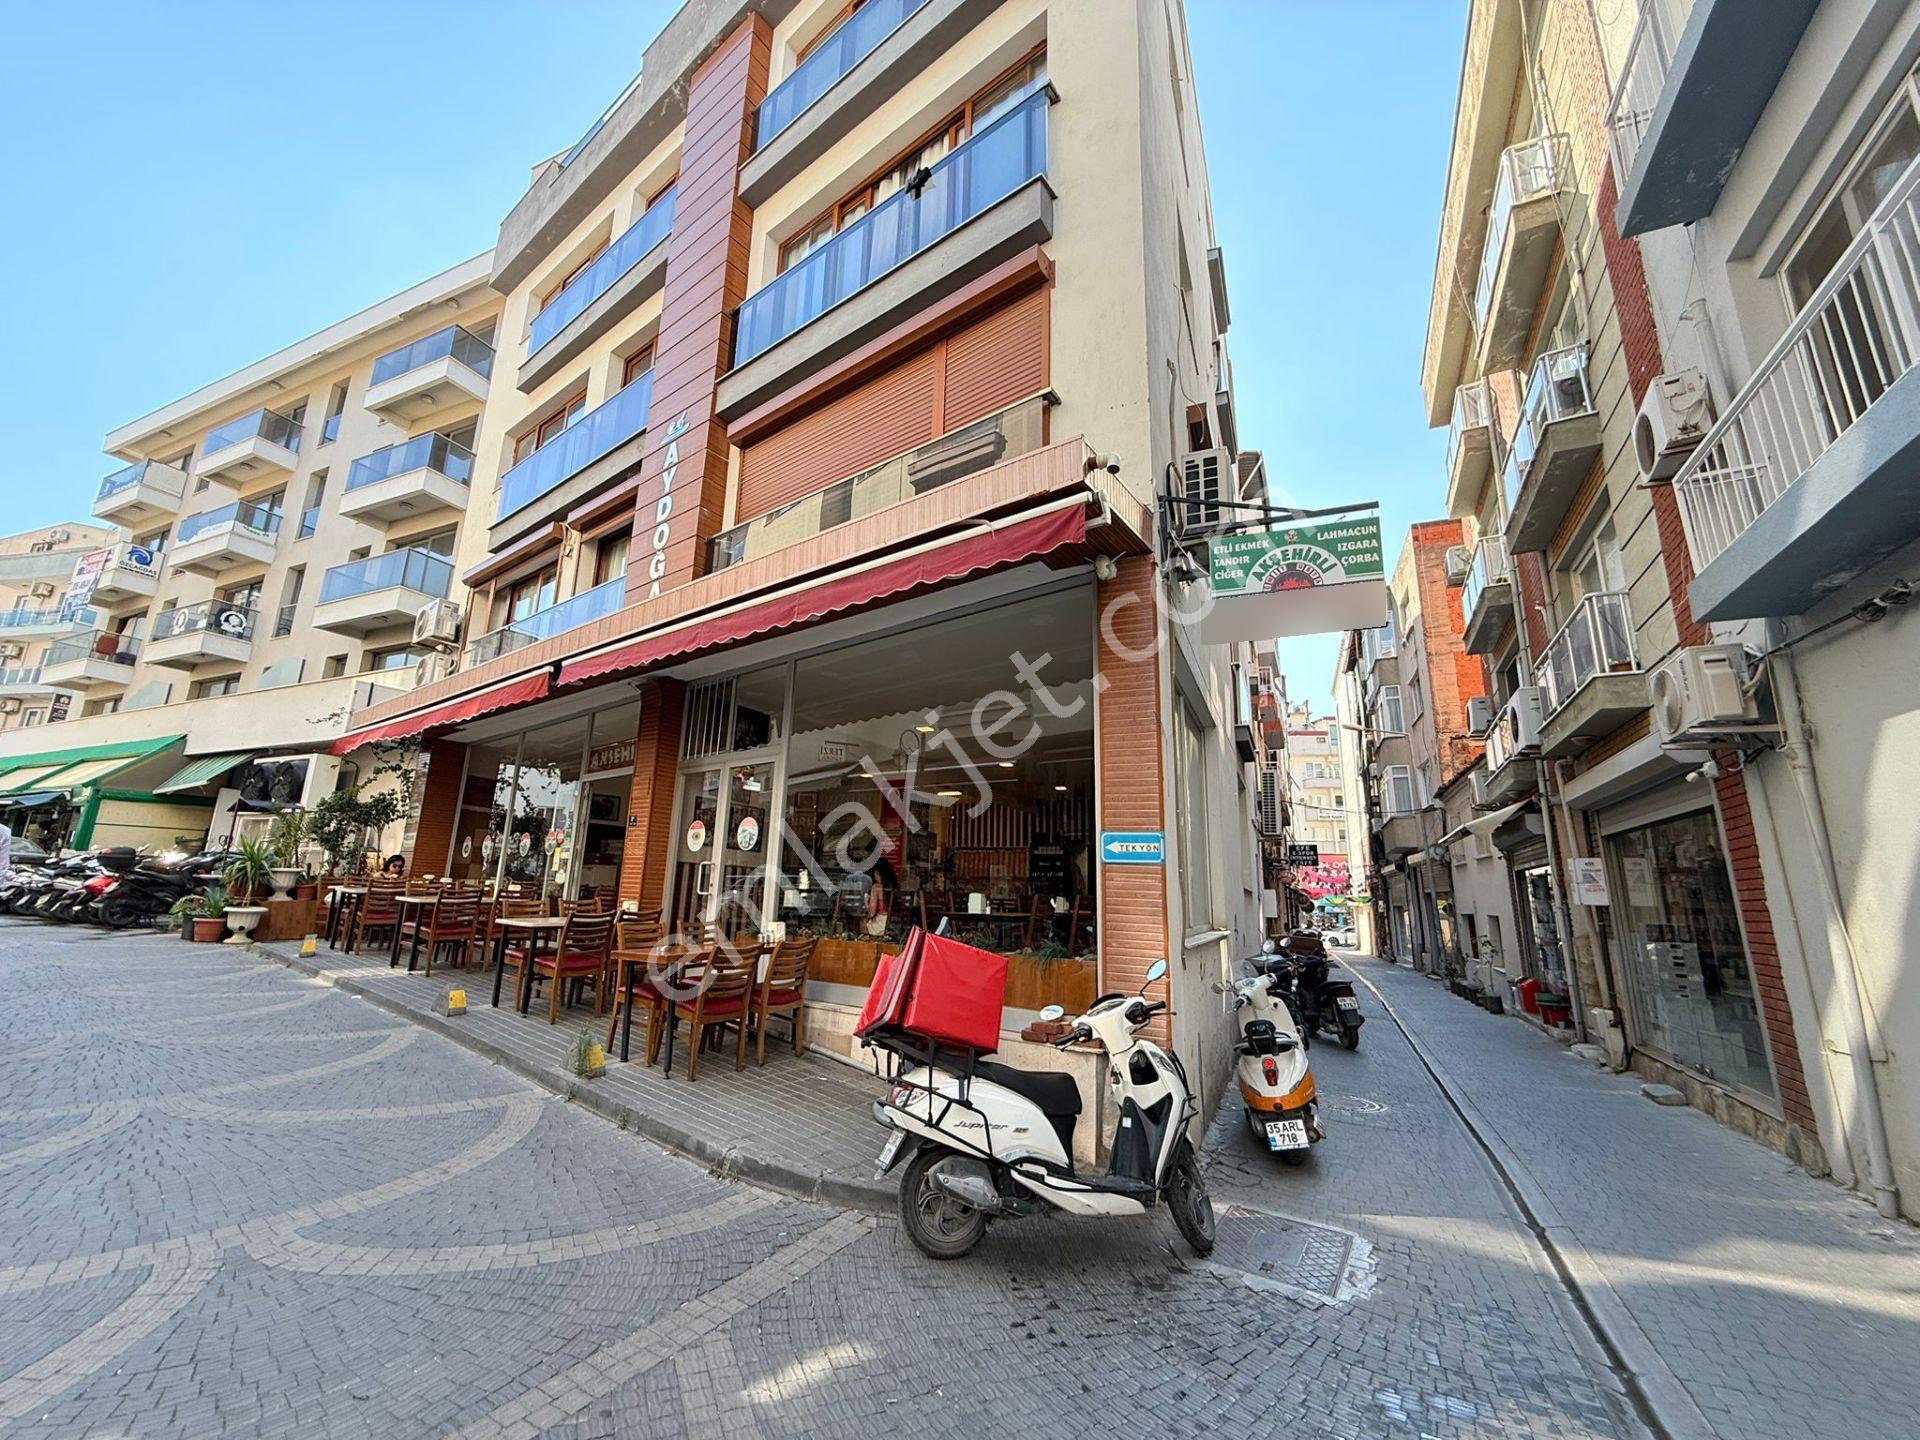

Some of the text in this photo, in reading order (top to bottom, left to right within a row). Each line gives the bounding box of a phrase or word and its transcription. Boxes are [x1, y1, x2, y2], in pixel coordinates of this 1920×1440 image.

[649, 441, 680, 599] AYDOĞA
[1316, 525, 1378, 541] LAHMACUN
[1235, 539, 1270, 552] EKMEK
[1337, 539, 1379, 552] IZGARA
[1213, 556, 1251, 568] TANDIR
[1252, 546, 1338, 582] AKŞEHİRLİ
[1341, 553, 1380, 568] ÇORBA
[1214, 568, 1244, 581] CİĞER
[1267, 1121, 1304, 1134] 35 ARL
[1279, 1133, 1298, 1145] 718
